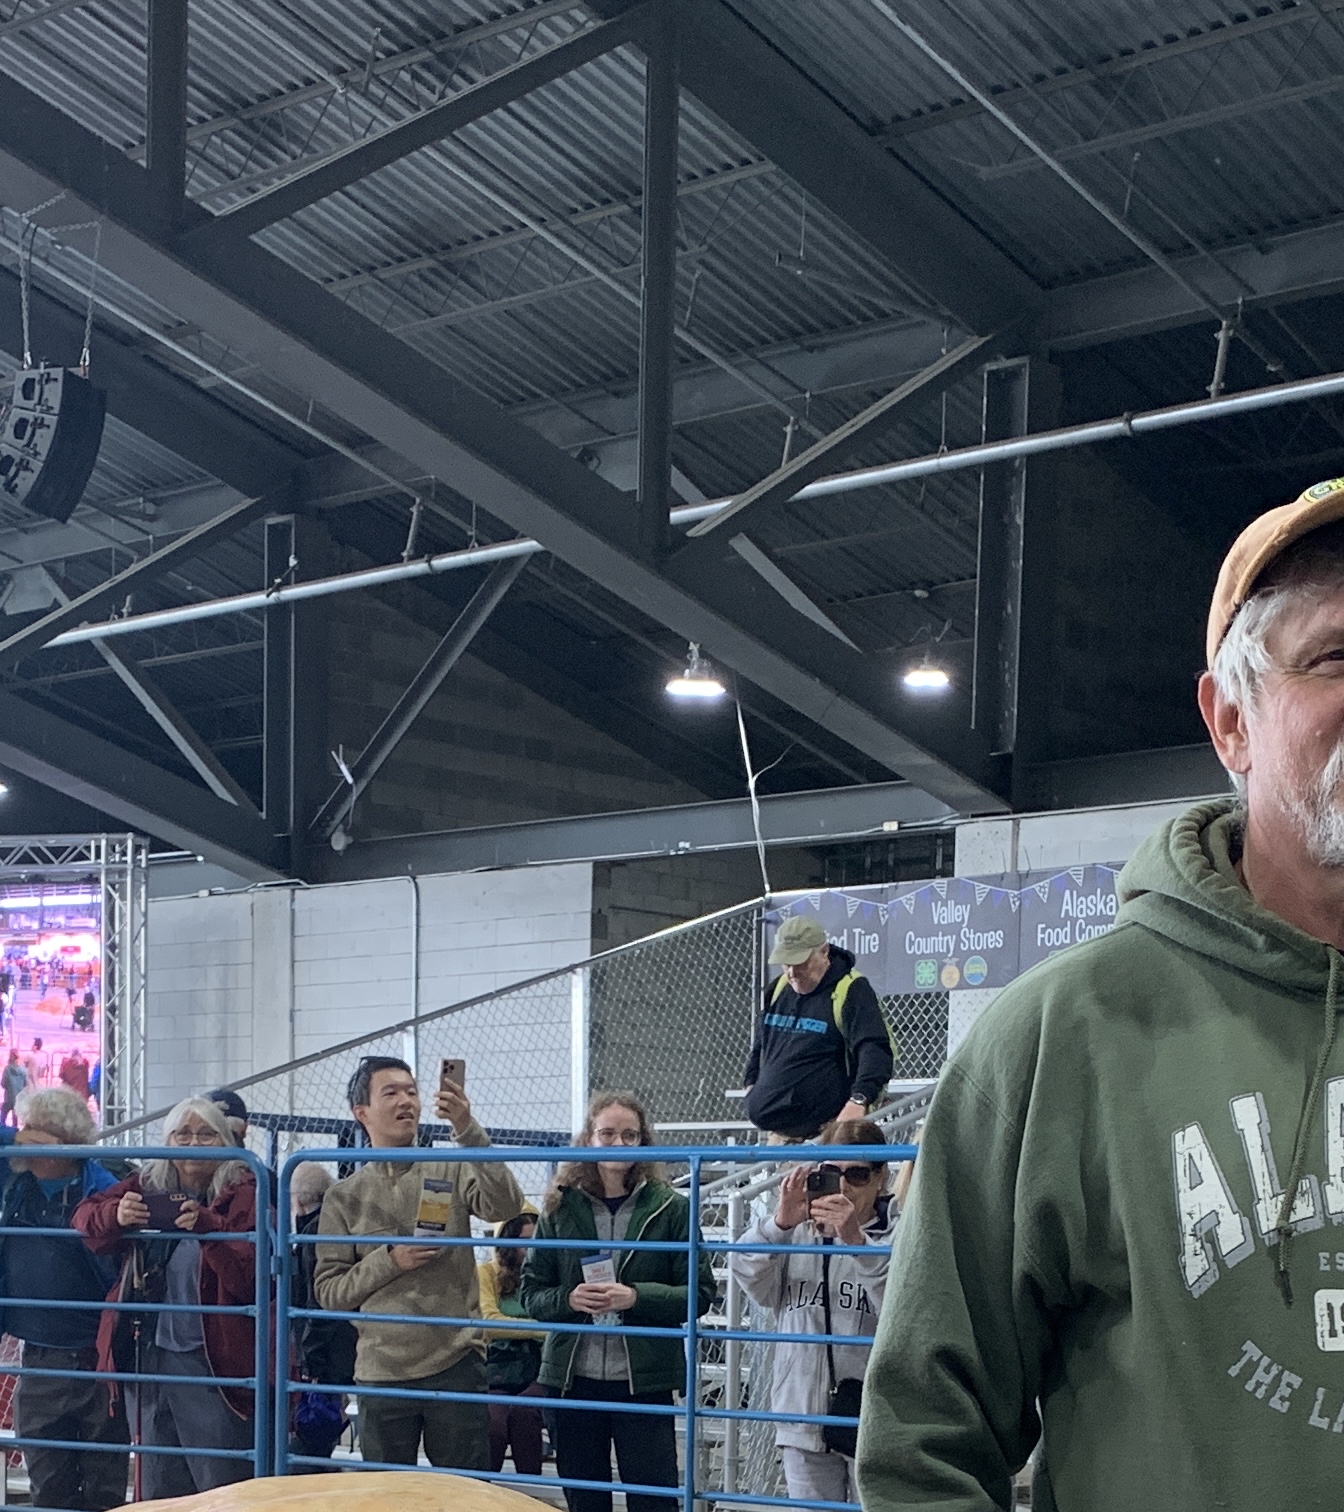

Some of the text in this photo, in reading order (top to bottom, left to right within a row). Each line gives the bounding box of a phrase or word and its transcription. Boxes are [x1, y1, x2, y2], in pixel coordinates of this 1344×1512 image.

[931, 901, 971, 928] Valley
[1060, 887, 1117, 919] Alaska
[852, 927, 880, 955] Tire
[904, 927, 1004, 957] Country Stores
[1037, 920, 1071, 947] Food
[1226, 1339, 1304, 1413] THE
